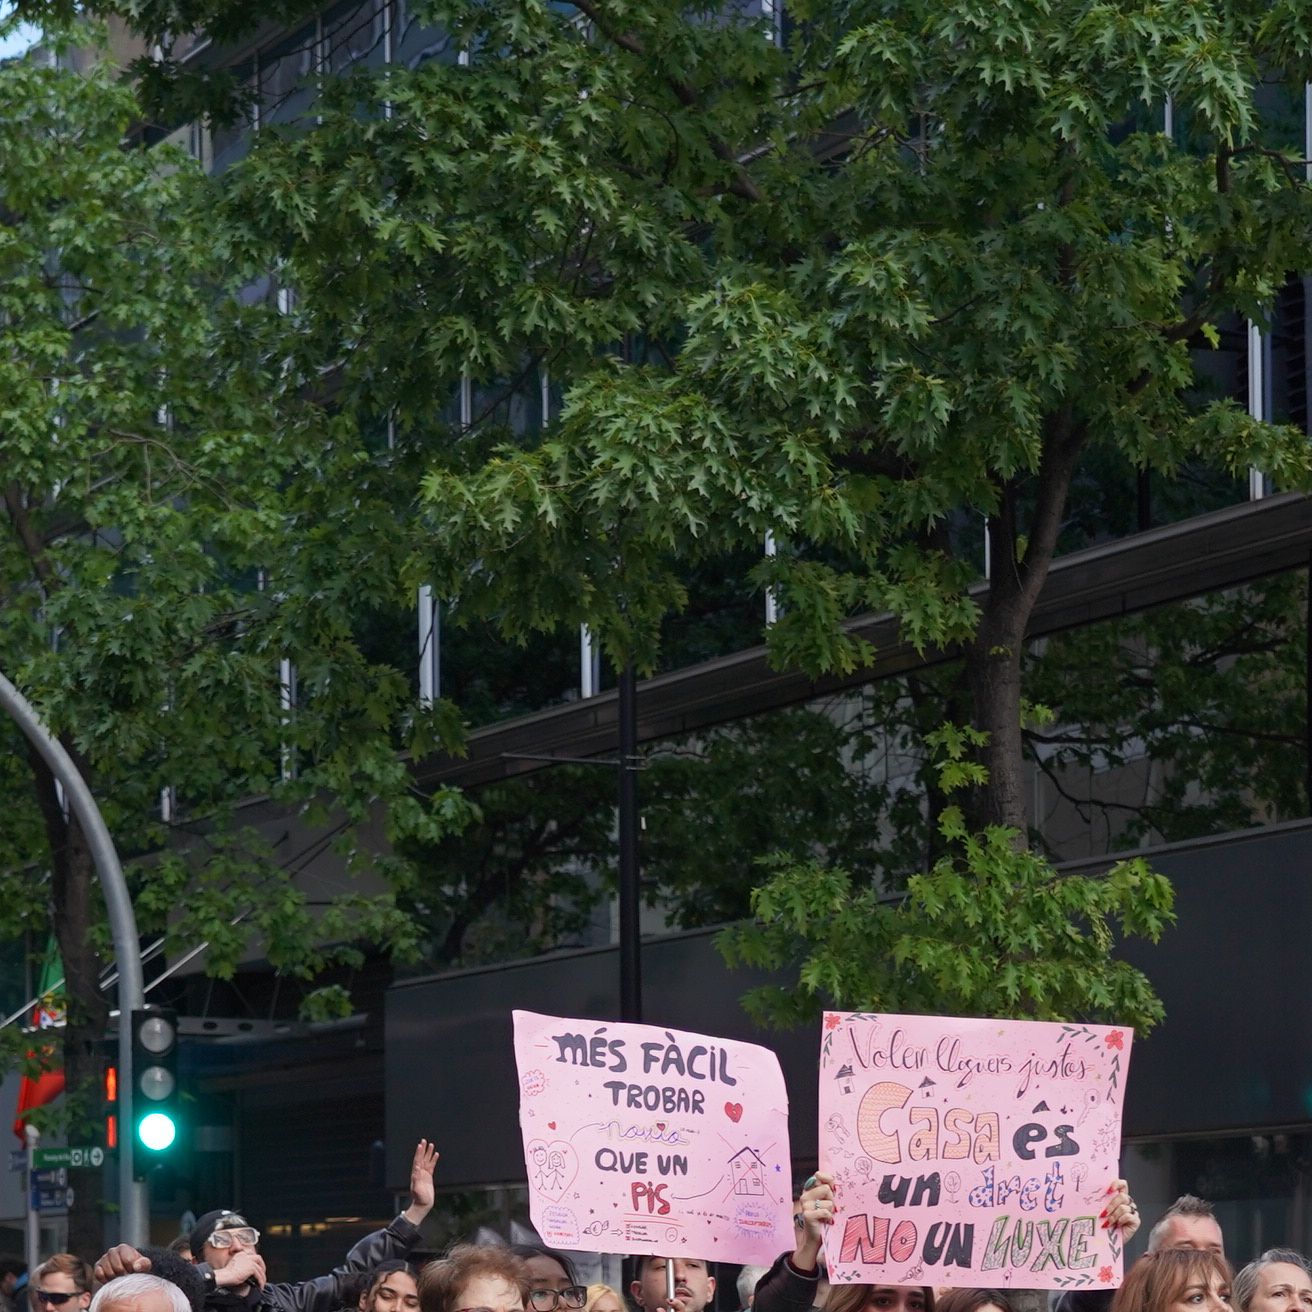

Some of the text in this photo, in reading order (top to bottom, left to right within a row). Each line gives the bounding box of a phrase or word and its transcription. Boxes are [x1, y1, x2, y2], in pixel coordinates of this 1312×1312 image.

[552, 1027, 627, 1073] MÉS
[849, 1024, 928, 1069] Volem
[1017, 1043, 1090, 1098] justos
[603, 1081, 705, 1115] TROBAR
[857, 1081, 1001, 1165] Casa
[595, 1148, 688, 1176] QUE UN
[878, 1161, 1065, 1213] un dret
[839, 1213, 1097, 1272] NO UN LUXE
